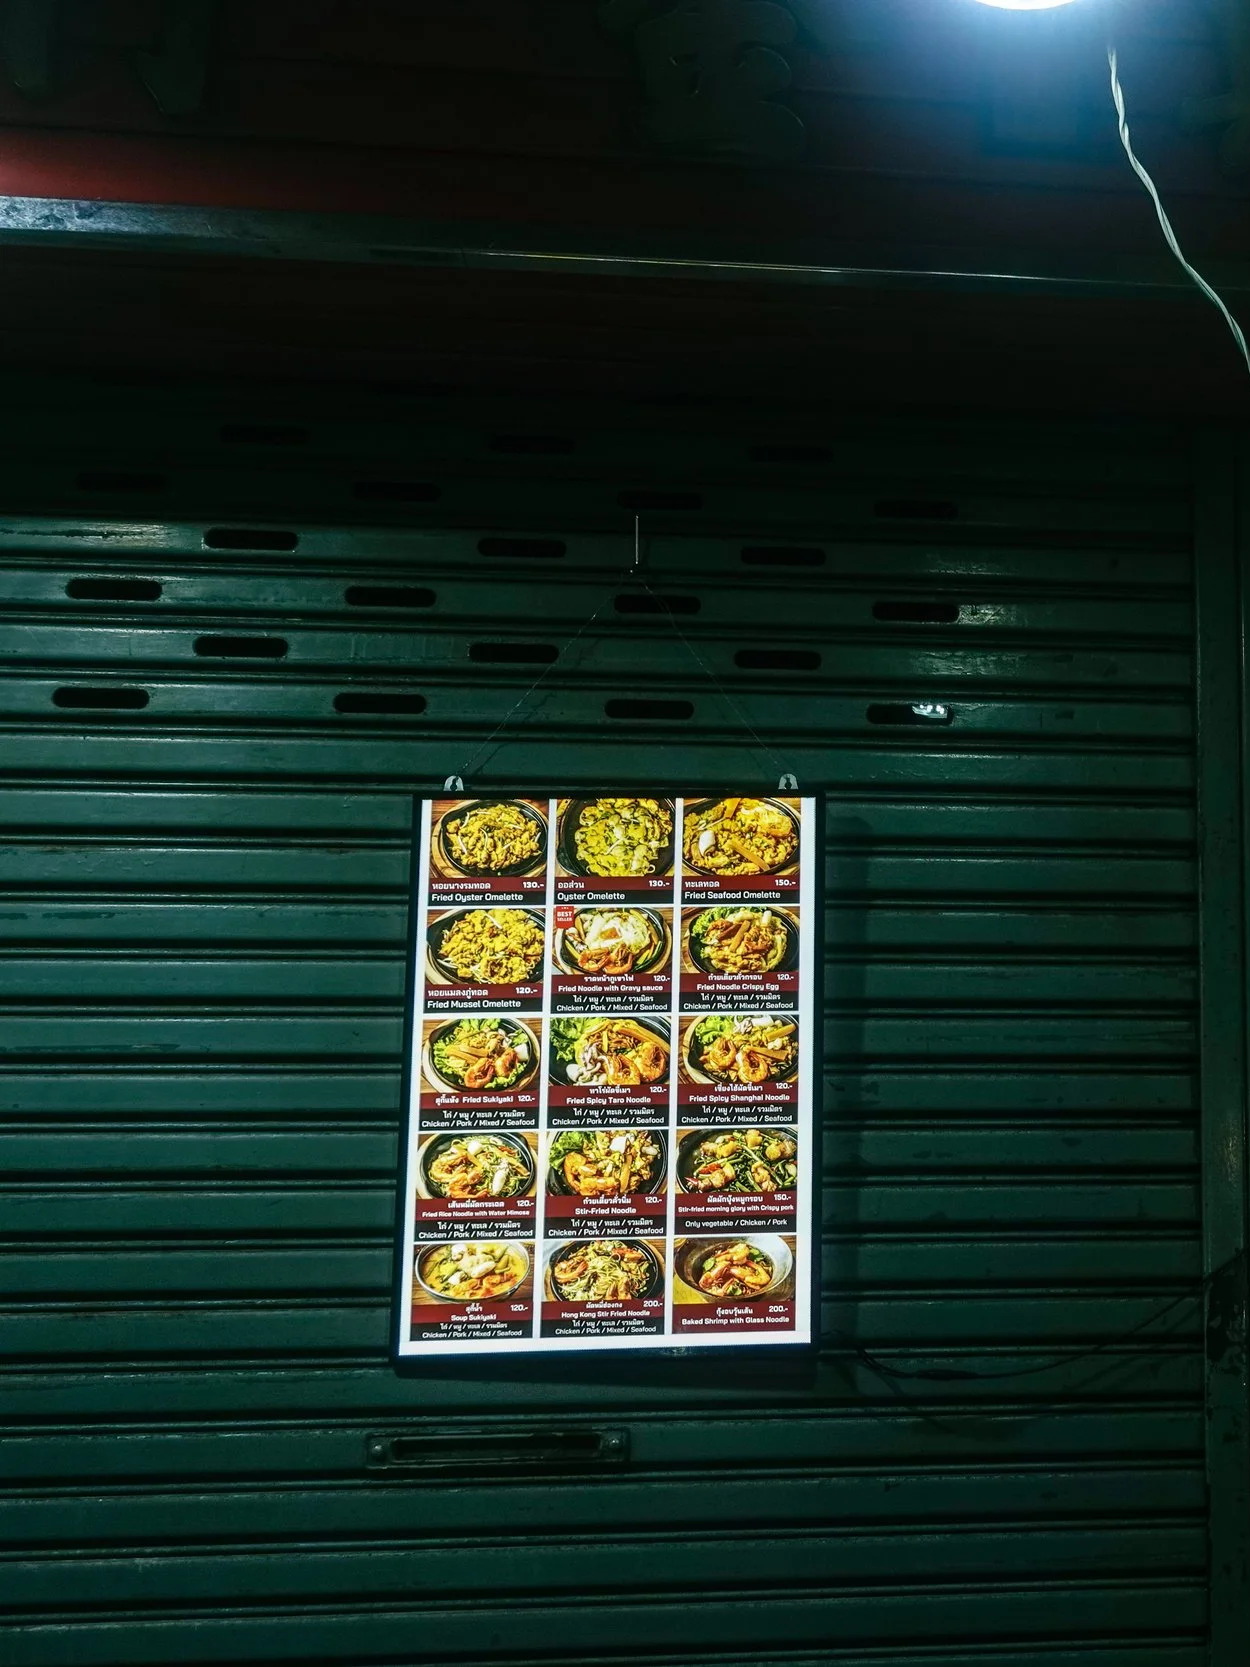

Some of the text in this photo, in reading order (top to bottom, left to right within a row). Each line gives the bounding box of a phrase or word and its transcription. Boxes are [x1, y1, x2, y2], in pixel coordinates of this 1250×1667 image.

[523, 881, 544, 889] 130.-
[432, 893, 523, 903] Fried Oyster Omelette
[557, 892, 625, 901] Oyster Omelette
[707, 891, 741, 899] Seafood
[516, 987, 537, 995] 120.-
[620, 985, 640, 993] Gravy
[742, 983, 764, 991] Crispy
[766, 983, 779, 991] Egg
[427, 1001, 449, 1009] Fried
[587, 1097, 607, 1105] Spicy
[709, 1095, 729, 1103] Spicy
[731, 1094, 763, 1102] Shanghai
[685, 1220, 701, 1228] Only
[702, 1220, 734, 1228] vegetable
[740, 1219, 766, 1227] Chicken
